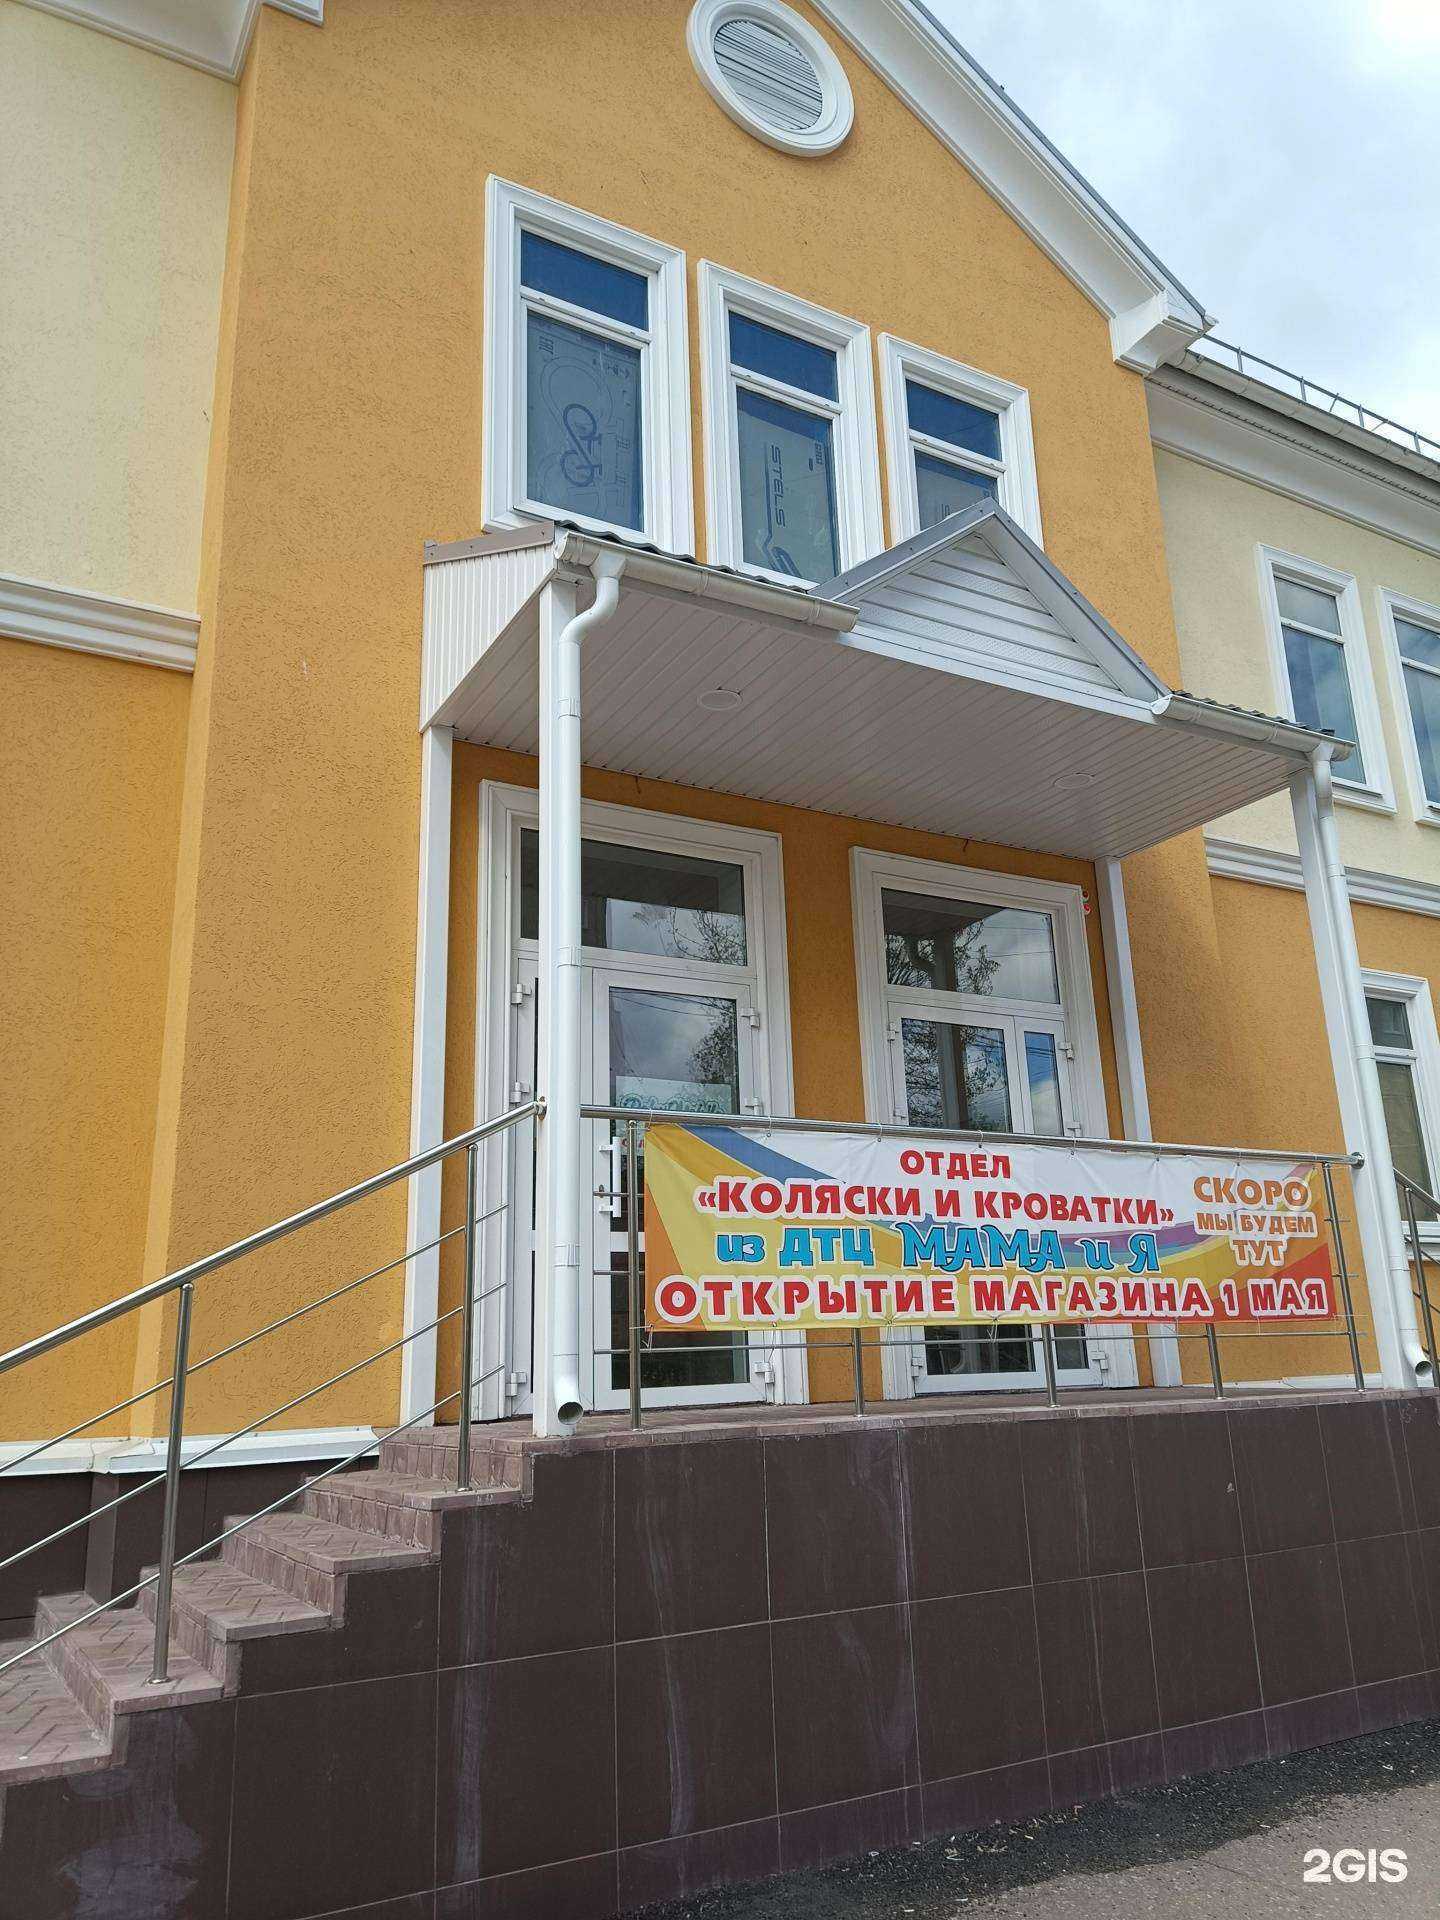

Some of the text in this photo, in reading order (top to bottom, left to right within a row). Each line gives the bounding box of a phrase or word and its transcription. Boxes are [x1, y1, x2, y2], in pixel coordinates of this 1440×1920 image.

[770, 444, 786, 528] STELS
[899, 1149, 1011, 1181] ОТДЕЛ
[698, 1180, 1175, 1226] «КОЛЯСКИ И КРОВАТКИ»
[1193, 1175, 1309, 1208] СКОРО
[1196, 1211, 1314, 1235] МЫ БУДЕМ
[716, 1222, 1161, 1274] из ДТЦ МАМА и Я
[1232, 1239, 1286, 1262] ТУТ
[660, 1279, 1328, 1318] ОТКРЫТИЕ МАГАЗИНА 1 МАЯ
